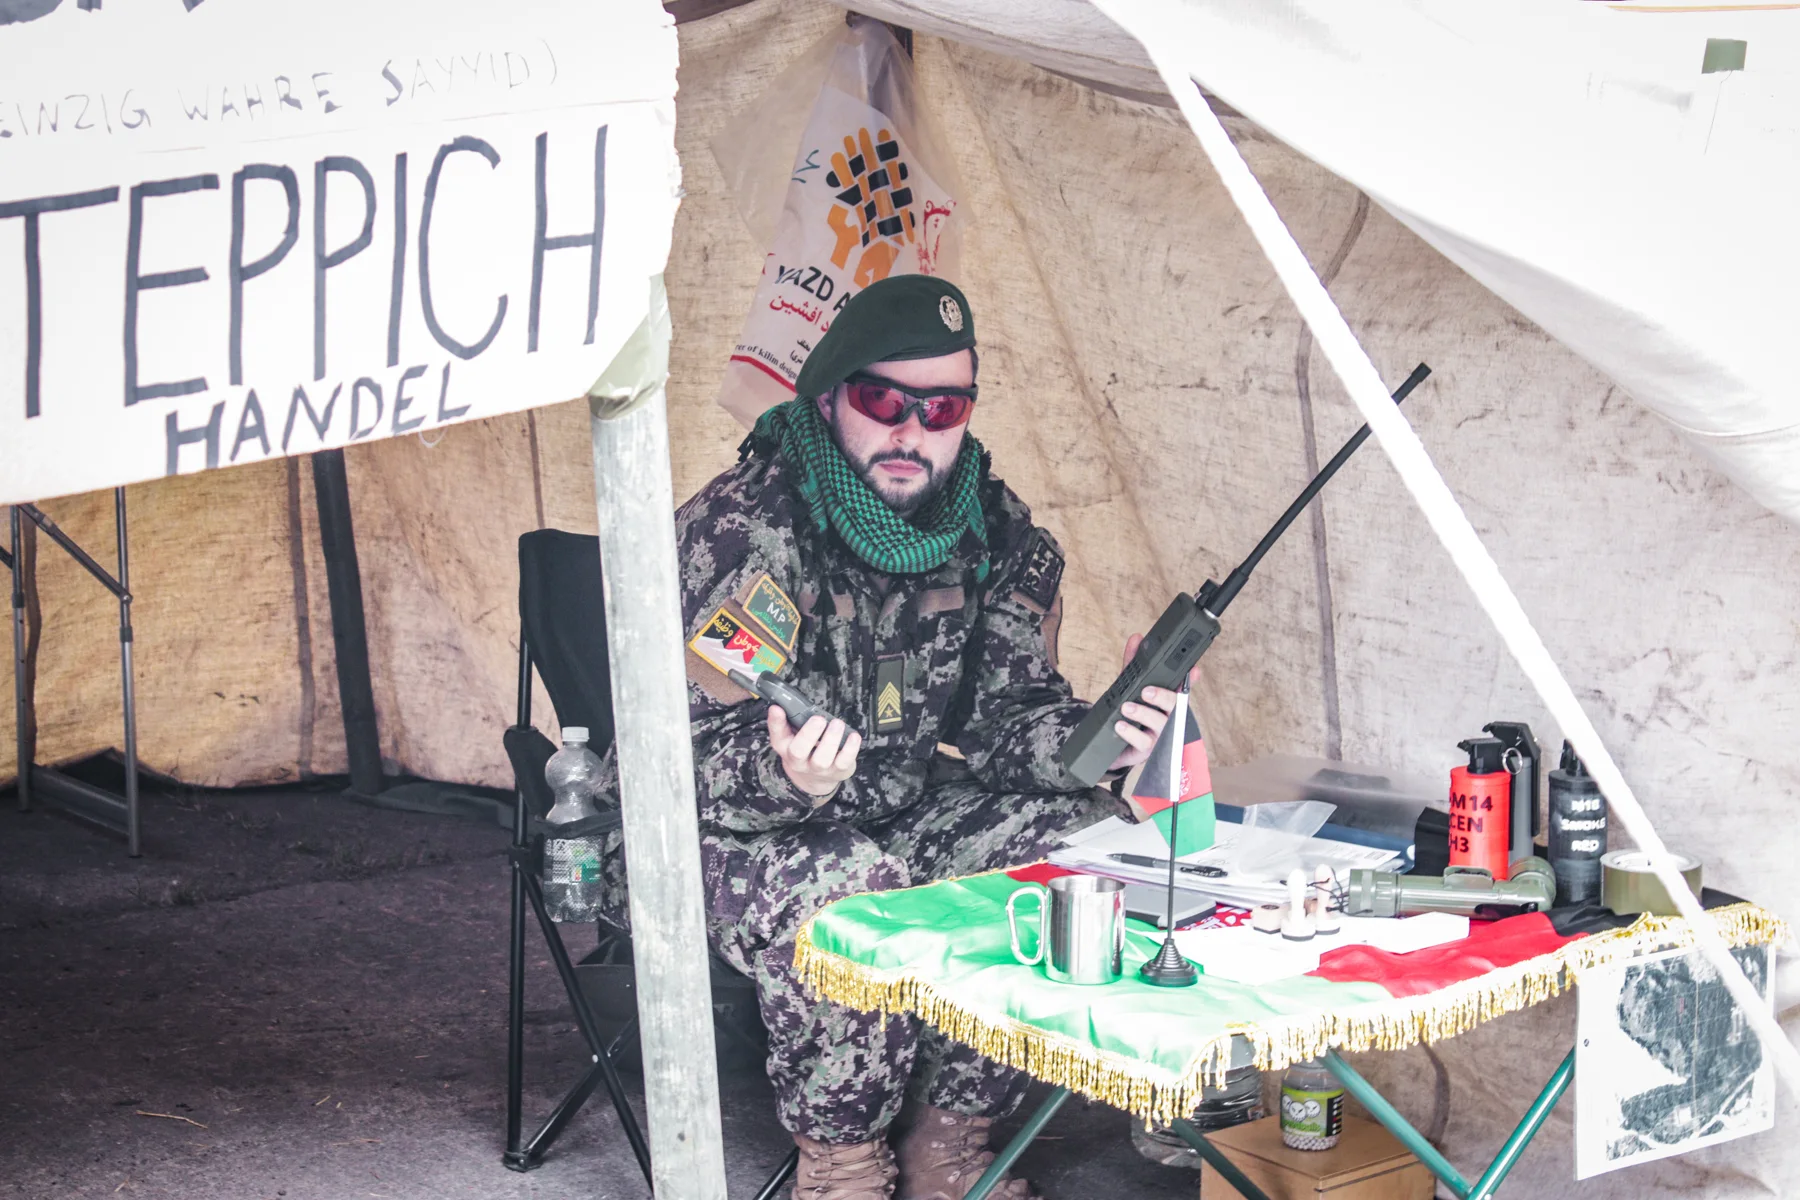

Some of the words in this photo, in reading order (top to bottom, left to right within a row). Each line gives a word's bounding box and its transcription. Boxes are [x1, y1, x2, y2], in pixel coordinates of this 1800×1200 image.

[0, 89, 151, 137] INZIG
[177, 72, 342, 121] WAHRE
[0, 125, 608, 419] TEPPICH
[774, 264, 834, 302] YAZD
[760, 347, 779, 365] kilim
[165, 361, 471, 475] HANDEL
[1560, 816, 1607, 831] SMOKE
[1571, 839, 1600, 852] RED
